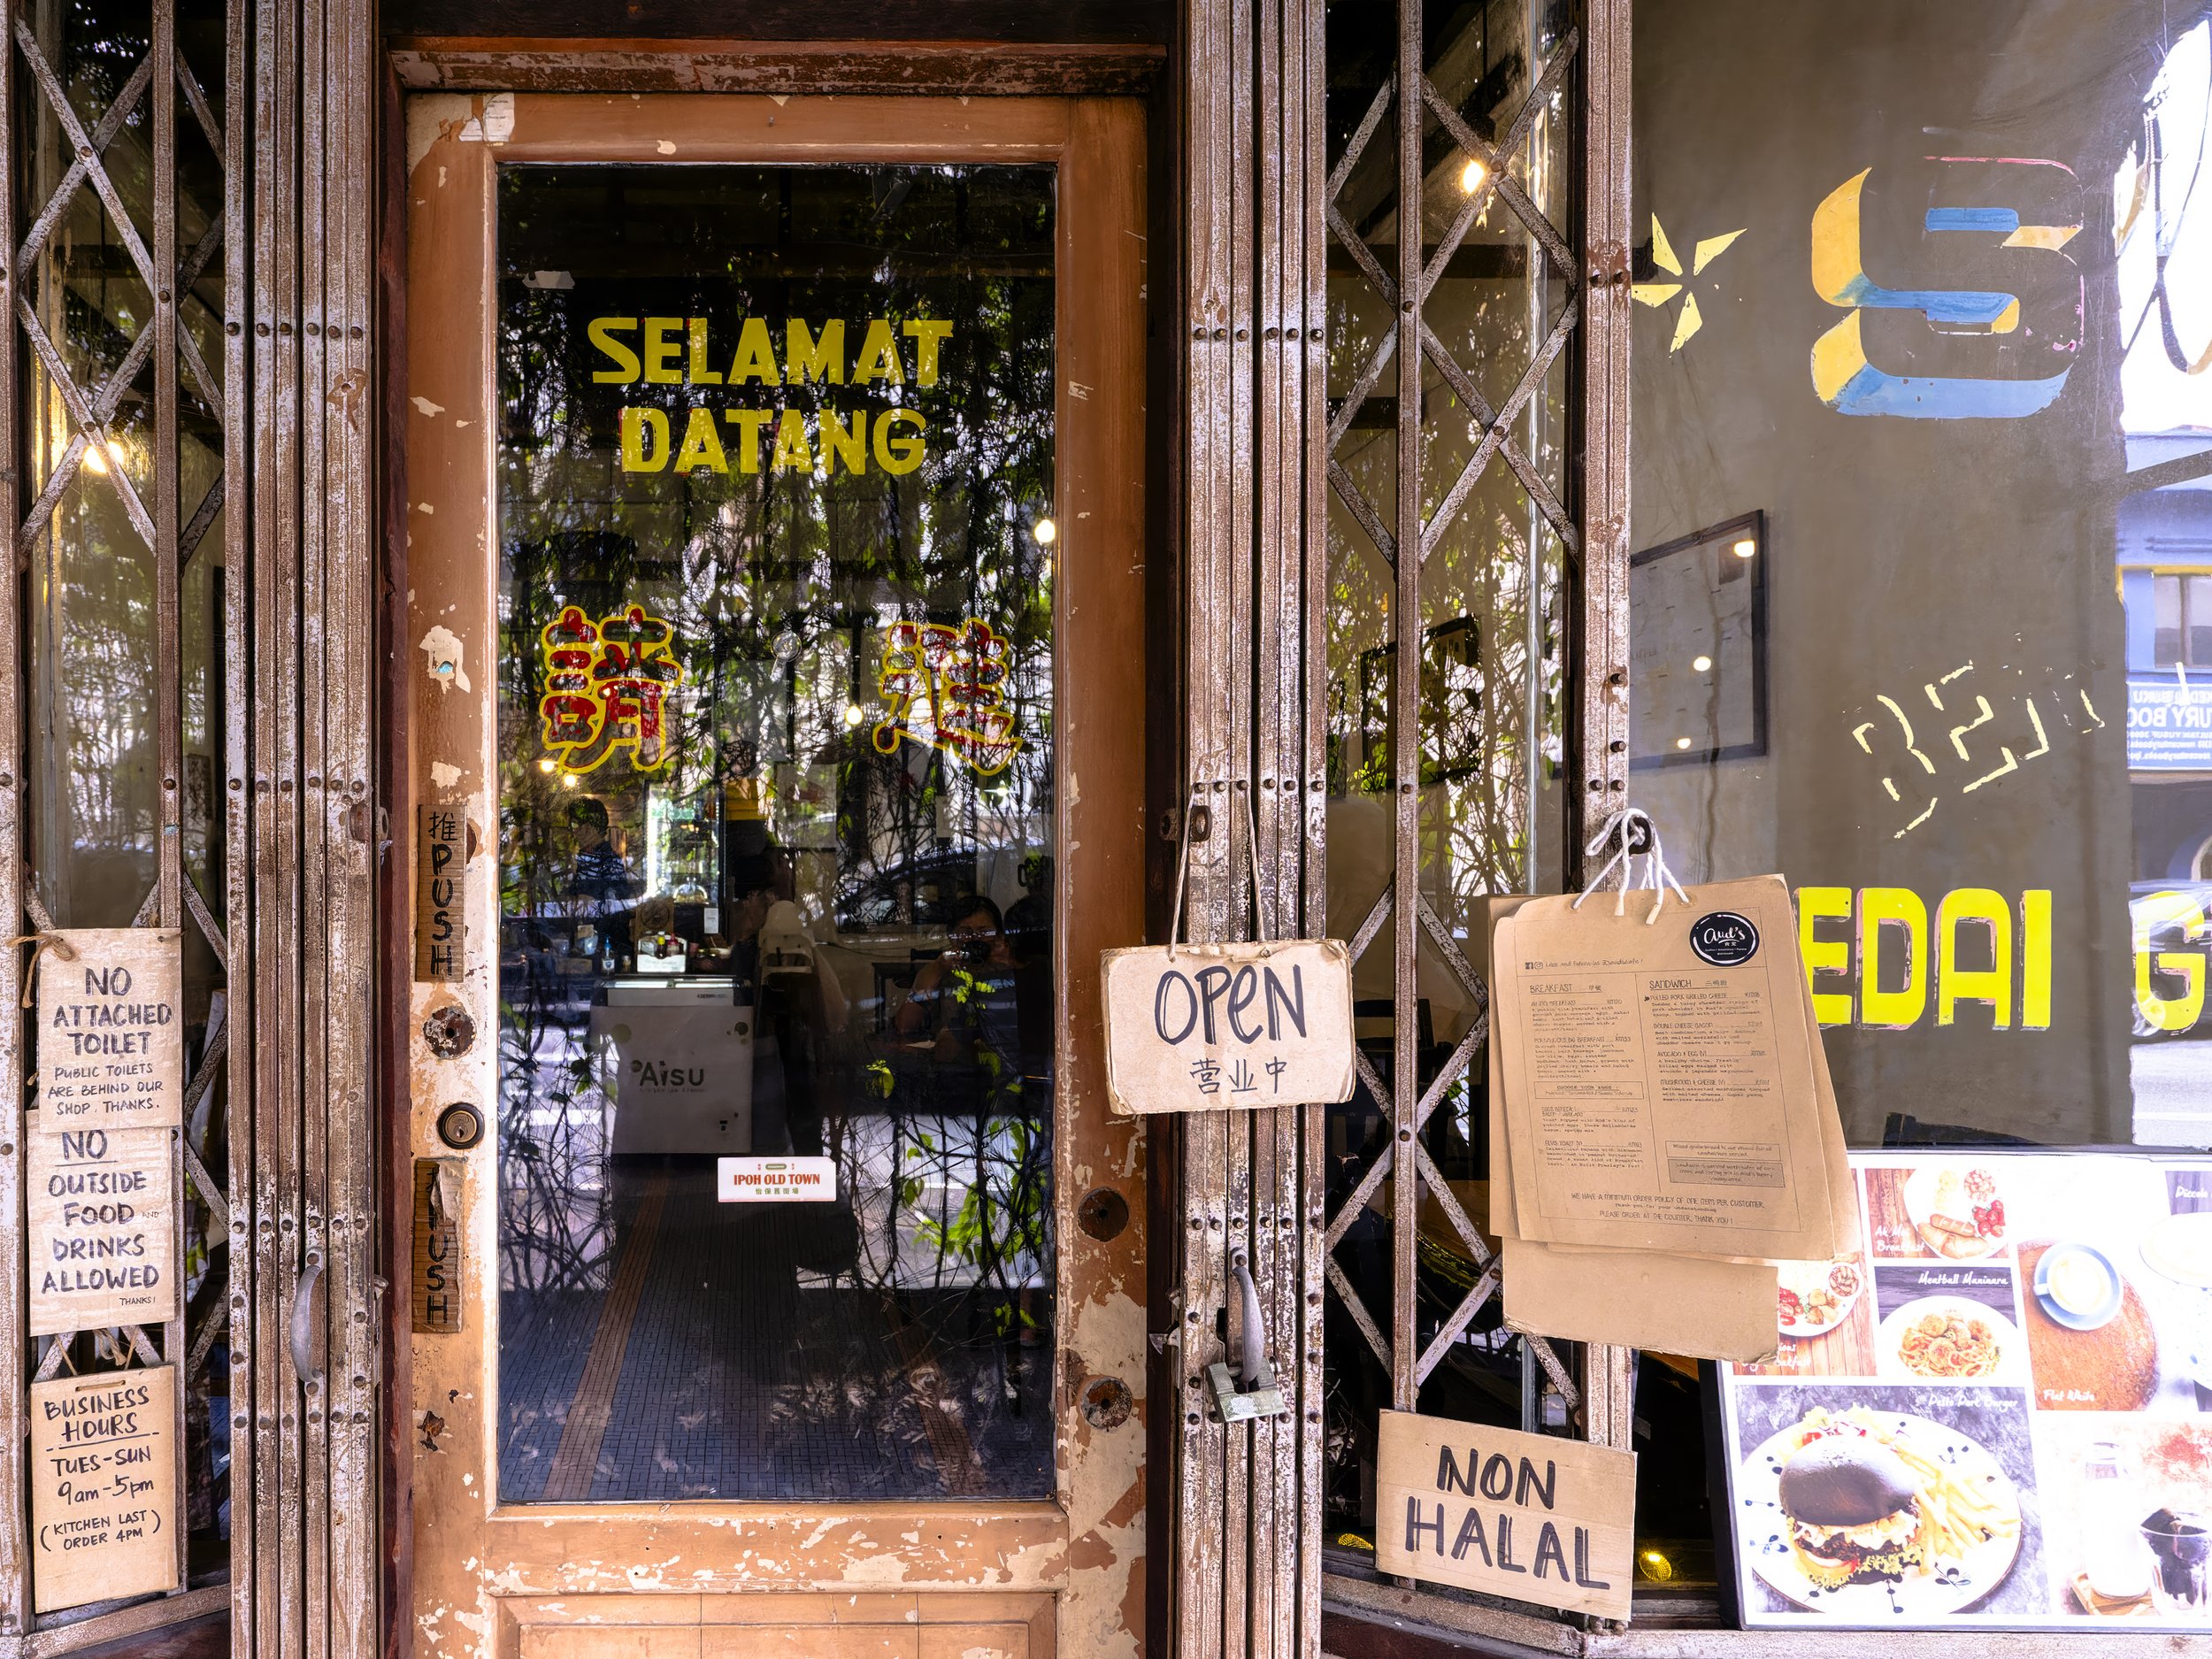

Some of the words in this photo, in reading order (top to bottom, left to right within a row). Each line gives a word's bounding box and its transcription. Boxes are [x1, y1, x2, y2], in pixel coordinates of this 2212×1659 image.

[588, 317, 954, 387] SELAMAT
[619, 407, 926, 476] DATANG
[428, 811, 457, 841] 推
[431, 843, 453, 976] PUSH
[85, 967, 132, 996] NO
[1530, 984, 1573, 994] BREAKFAST
[1649, 979, 1692, 989] SANDWICH
[54, 1003, 172, 1028] ATTACHED
[67, 1032, 152, 1056] TOILET
[55, 1067, 100, 1080] PUBLIC
[105, 1064, 153, 1077] TOILETS
[1189, 1056, 1287, 1094] 营业中
[48, 1086, 74, 1099] ARE
[81, 1082, 130, 1097] BEHIND
[137, 1080, 164, 1094] OUR
[61, 1129, 108, 1161] NO
[48, 1171, 147, 1197] OUTSIDE
[733, 1174, 761, 1186] IPOH
[764, 1174, 786, 1186] OLD
[788, 1173, 821, 1186] TOWN
[64, 1202, 134, 1228] FOOD
[142, 1210, 160, 1219] AND
[1599, 1210, 1620, 1218] PLEASE
[53, 1233, 145, 1262] DRINKS
[42, 1264, 159, 1294] ALLOWED
[1917, 1271, 1960, 1285] Meatball
[43, 1386, 150, 1421] BUSINESS
[2043, 1389, 2064, 1402] Flat
[61, 1412, 138, 1443] HOURS
[1437, 1445, 1555, 1510] NON
[63, 1532, 108, 1551] ORDER
[1405, 1495, 1610, 1590] HALAL
